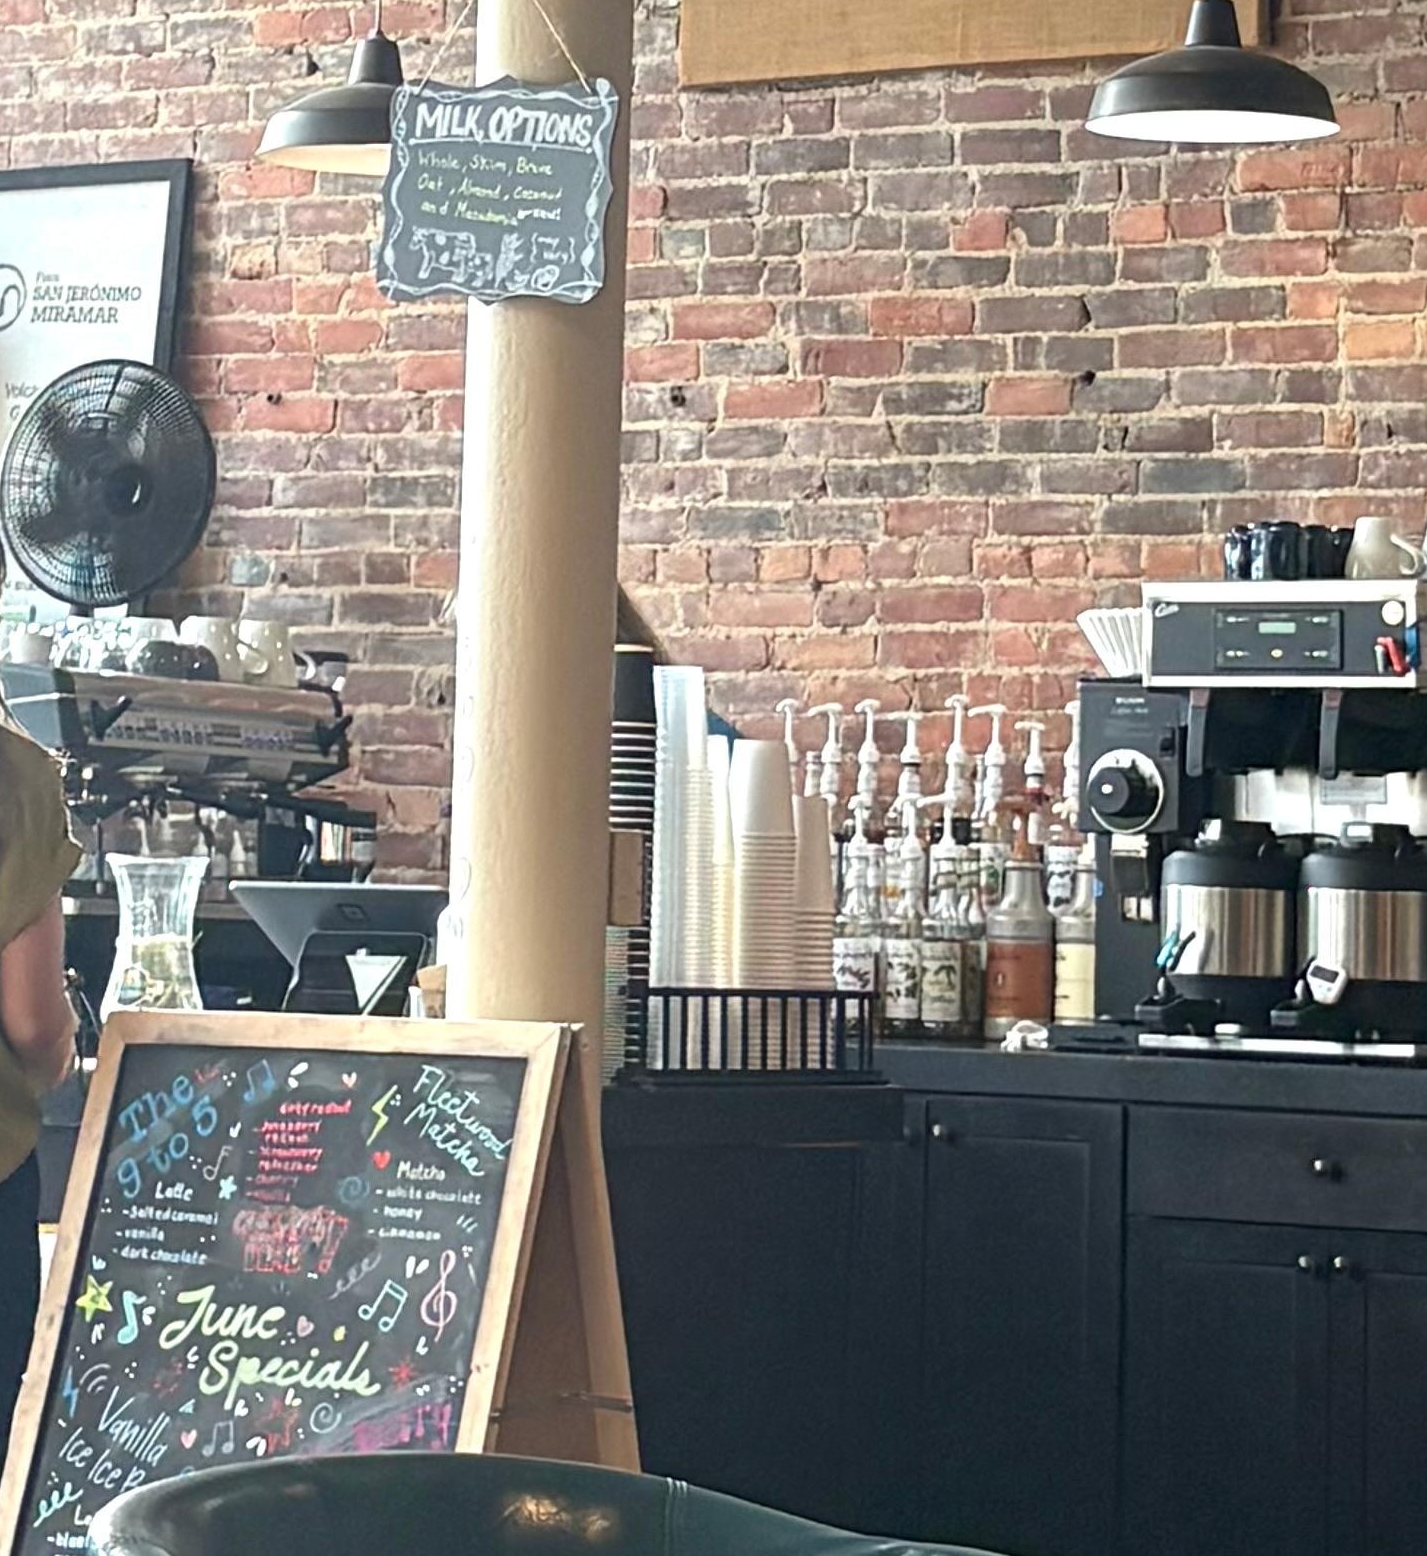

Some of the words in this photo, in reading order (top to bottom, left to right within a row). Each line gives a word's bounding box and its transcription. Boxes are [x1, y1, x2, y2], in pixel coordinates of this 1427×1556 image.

[415, 103, 482, 141] MILK
[488, 106, 593, 144] OPTIONS
[31, 306, 119, 323] MIRAMAR
[33, 286, 65, 301] SAN
[118, 1075, 194, 1143] The
[146, 1133, 189, 1173] to
[192, 1095, 217, 1136] 5
[404, 1102, 484, 1176] Matcha
[159, 1285, 285, 1350] June
[199, 1340, 381, 1411] Specials
[60, 1427, 93, 1468] Ice
[88, 1449, 121, 1489] Ice
[98, 1385, 170, 1467] Vanilla
